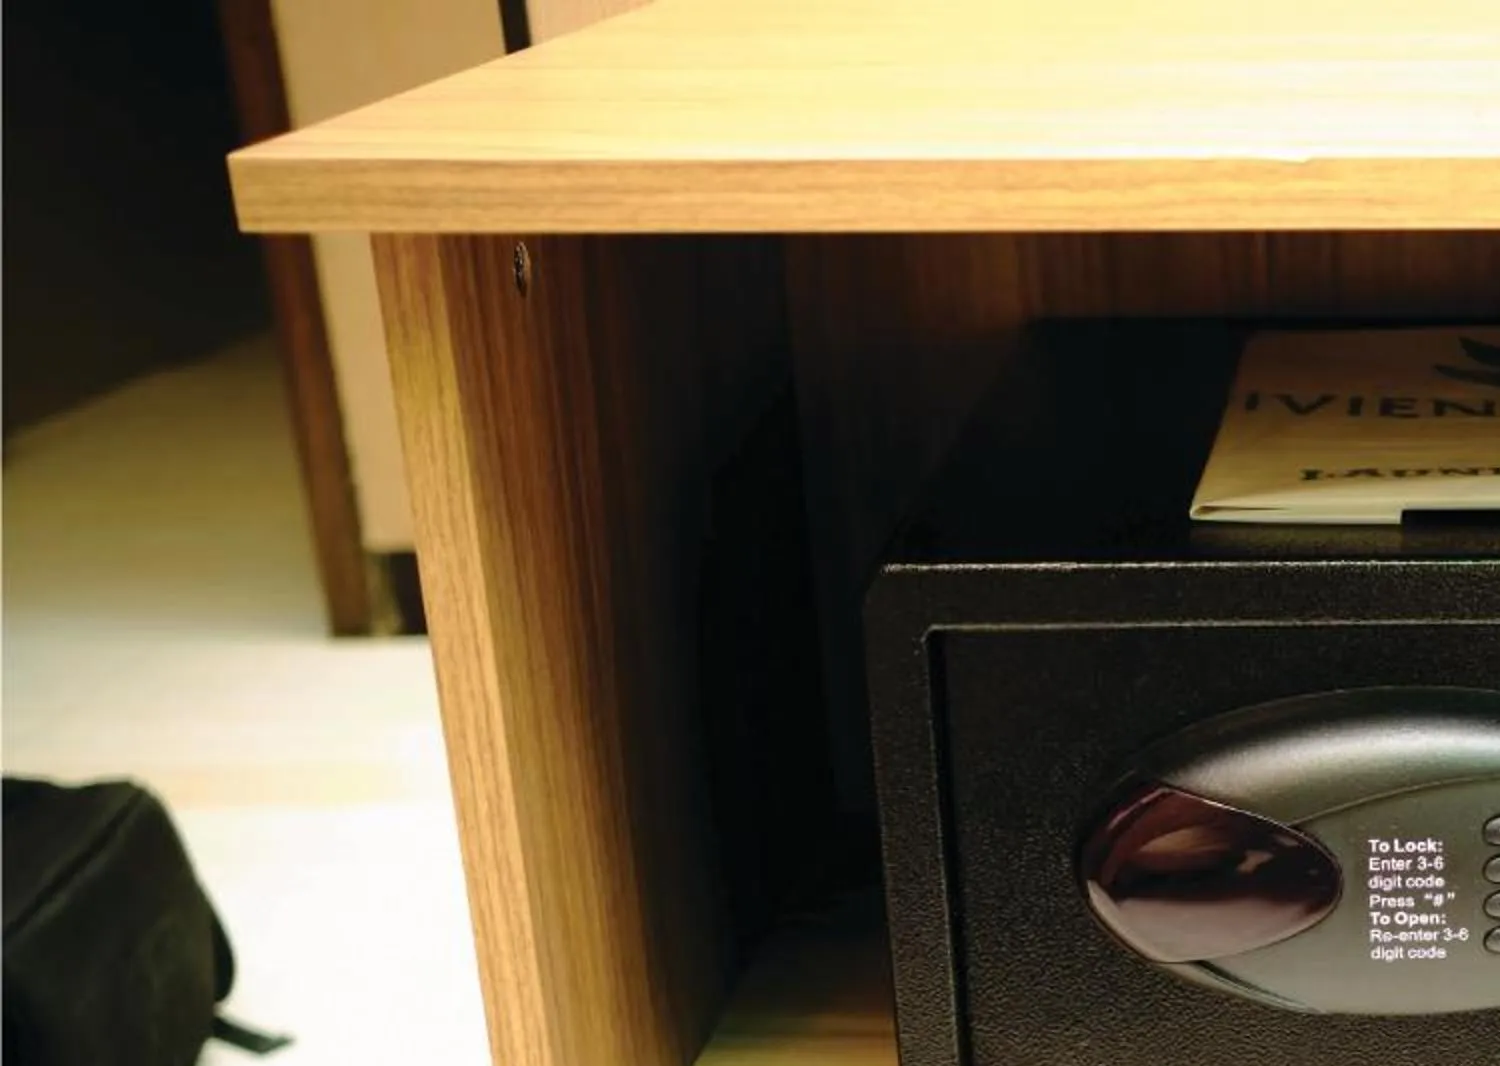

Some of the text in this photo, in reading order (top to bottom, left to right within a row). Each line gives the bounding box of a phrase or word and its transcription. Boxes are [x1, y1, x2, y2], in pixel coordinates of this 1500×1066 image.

[1368, 838, 1444, 852] To Lock:
[1368, 857, 1444, 870] Enter 3-6
[1368, 875, 1445, 891] digit code
[1369, 894, 1415, 907] Press
[1369, 911, 1447, 927] To Open:
[1369, 928, 1469, 942] Re-enter 3-6
[1370, 946, 1447, 963] digit code
